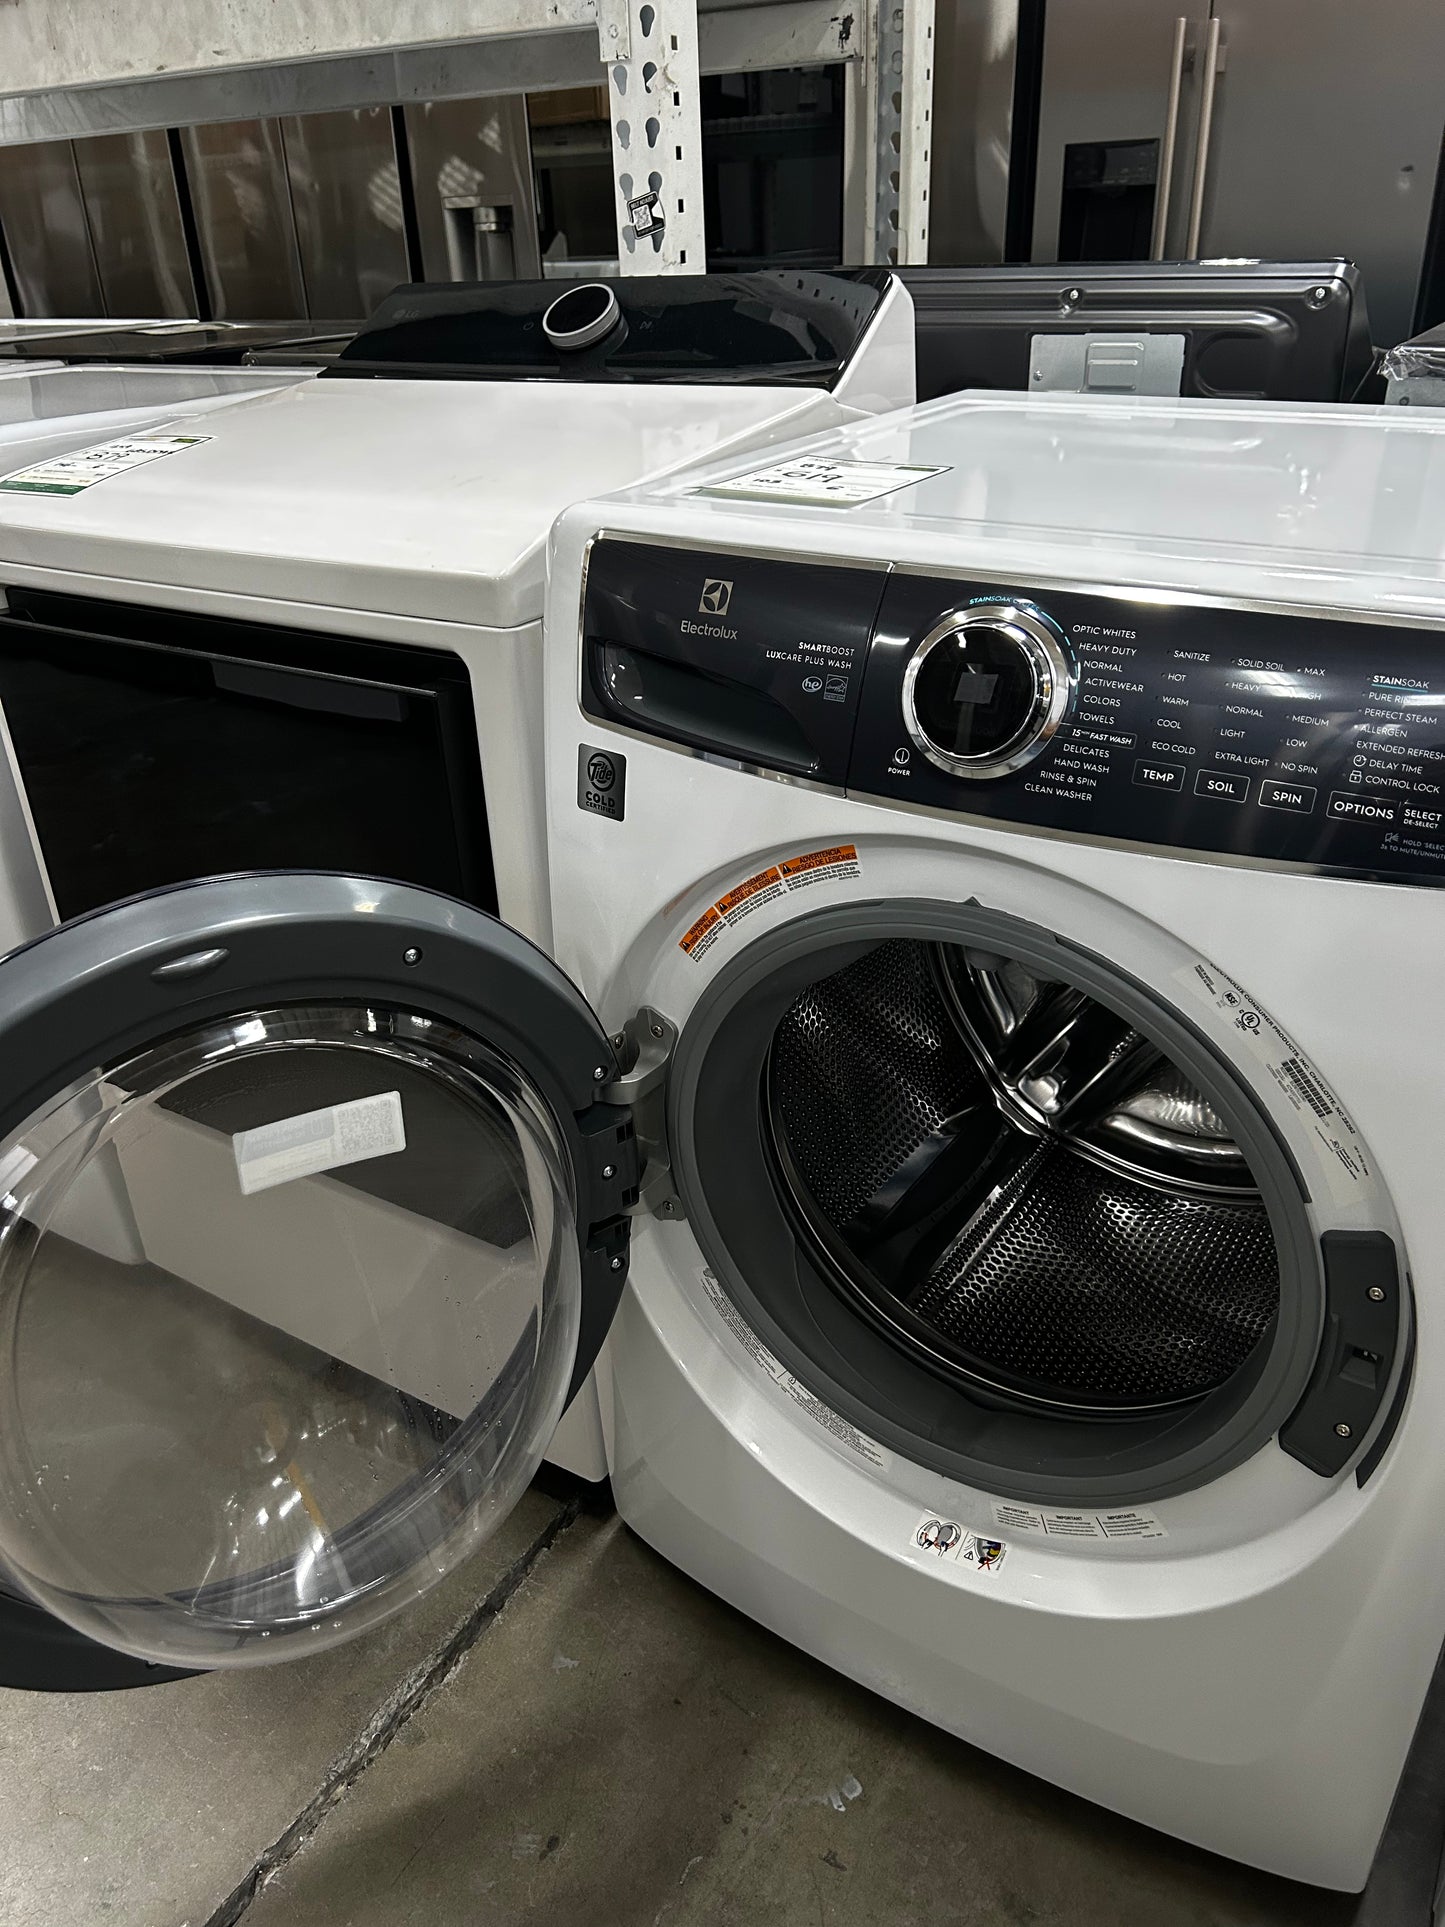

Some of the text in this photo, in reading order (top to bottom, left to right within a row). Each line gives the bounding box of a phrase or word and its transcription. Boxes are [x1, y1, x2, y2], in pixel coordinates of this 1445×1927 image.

[782, 470, 844, 483] 619
[968, 595, 1012, 605] STAINSOAK
[680, 619, 739, 640] Electrolux
[1072, 624, 1137, 639] OPTIC WHITES
[798, 641, 855, 656] SMARTBOOST
[1078, 642, 1138, 657] HEAVY DUTY
[765, 650, 852, 670] LUXCARE PLUS WASH
[1173, 650, 1211, 662] SANITIZE
[1083, 660, 1123, 673] NORMAL
[1237, 658, 1285, 672] SOLID SOIL
[1304, 667, 1326, 677] MAX
[804, 678, 820, 690] he
[1167, 673, 1187, 682] HOT
[1372, 674, 1430, 689] STAINSOAK
[1084, 677, 1144, 693] ACTIVEWEAR
[1231, 682, 1261, 692] HEAVY
[1083, 694, 1121, 707] COLORS
[1162, 696, 1189, 706] WARM
[1368, 691, 1393, 703] PURE
[1078, 711, 1115, 725] TOWELS
[1225, 705, 1264, 718] NORMAL
[1364, 707, 1438, 726] PERFECT STEAM
[1156, 718, 1182, 730] COOL
[1292, 714, 1330, 727] MEDIUM
[1220, 728, 1245, 739] LIGHT
[1360, 724, 1408, 738] ALLERGEN
[1089, 732, 1109, 741] FAST
[1109, 735, 1132, 745] WASH
[1286, 737, 1308, 748] LOW
[1063, 743, 1110, 758] DELICATES
[1151, 741, 1196, 756] ECO COLD
[1356, 740, 1407, 755] EXTENDED
[1053, 757, 1110, 774] HAND WASH
[1214, 751, 1269, 767] EXTRA LIGHT
[591, 761, 612, 781] Tide
[887, 767, 911, 777] POWER
[1280, 762, 1318, 775] NO SPIN
[1369, 759, 1424, 775] DELAY TIME
[1039, 770, 1097, 787] RINSE & SPIN
[1142, 768, 1175, 783] TEMP
[1024, 782, 1093, 801] CLEAN WASHER
[1207, 780, 1235, 794] SOIL
[1364, 775, 1441, 794] CONTROL LOCK
[585, 791, 615, 807] COLD
[1272, 791, 1302, 805] SPIN
[585, 801, 615, 814] CERTIFIED
[1334, 801, 1394, 820] OPTIONS
[1404, 808, 1443, 822] SELECT
[1403, 818, 1439, 830] DE-SELECT
[1402, 839, 1422, 847] HOLD
[791, 852, 857, 873] RIESGO DE LESIONES
[689, 914, 709, 936] WARNING
[1243, 993, 1274, 1027] CONSUMER
[1272, 1023, 1300, 1057] PRODUCTS,
[1299, 1057, 1310, 1072] INC.
[1308, 1070, 1337, 1108] CHARLOTTE,
[1335, 1106, 1346, 1117] NC
[1002, 1505, 1030, 1516] IMPORTANT
[1106, 1512, 1138, 1521] IMPORTANTE
[1055, 1514, 1083, 1522] IMPORTANT
